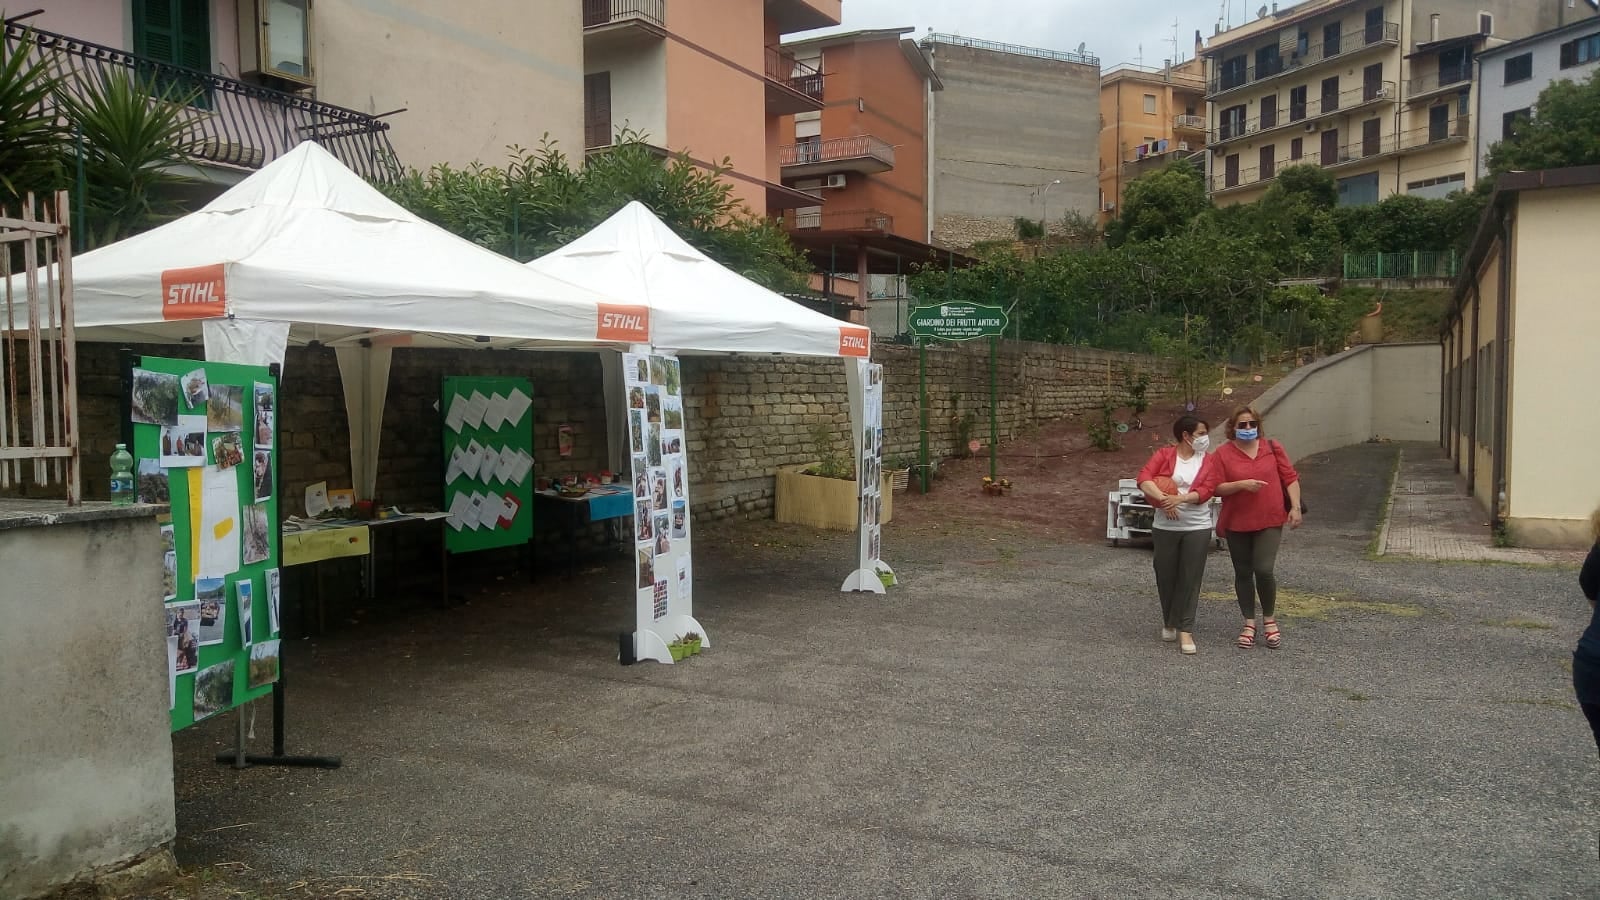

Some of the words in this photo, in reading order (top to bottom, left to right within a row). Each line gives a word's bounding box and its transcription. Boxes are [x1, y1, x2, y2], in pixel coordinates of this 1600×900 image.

[167, 281, 219, 305] STIHL
[601, 312, 645, 331] STIHL
[916, 318, 945, 327] GIARDINO
[946, 318, 956, 327] DEI
[957, 318, 977, 327] FRUTTI
[978, 318, 1000, 327] ANTICHI
[841, 335, 866, 349] STIHL
